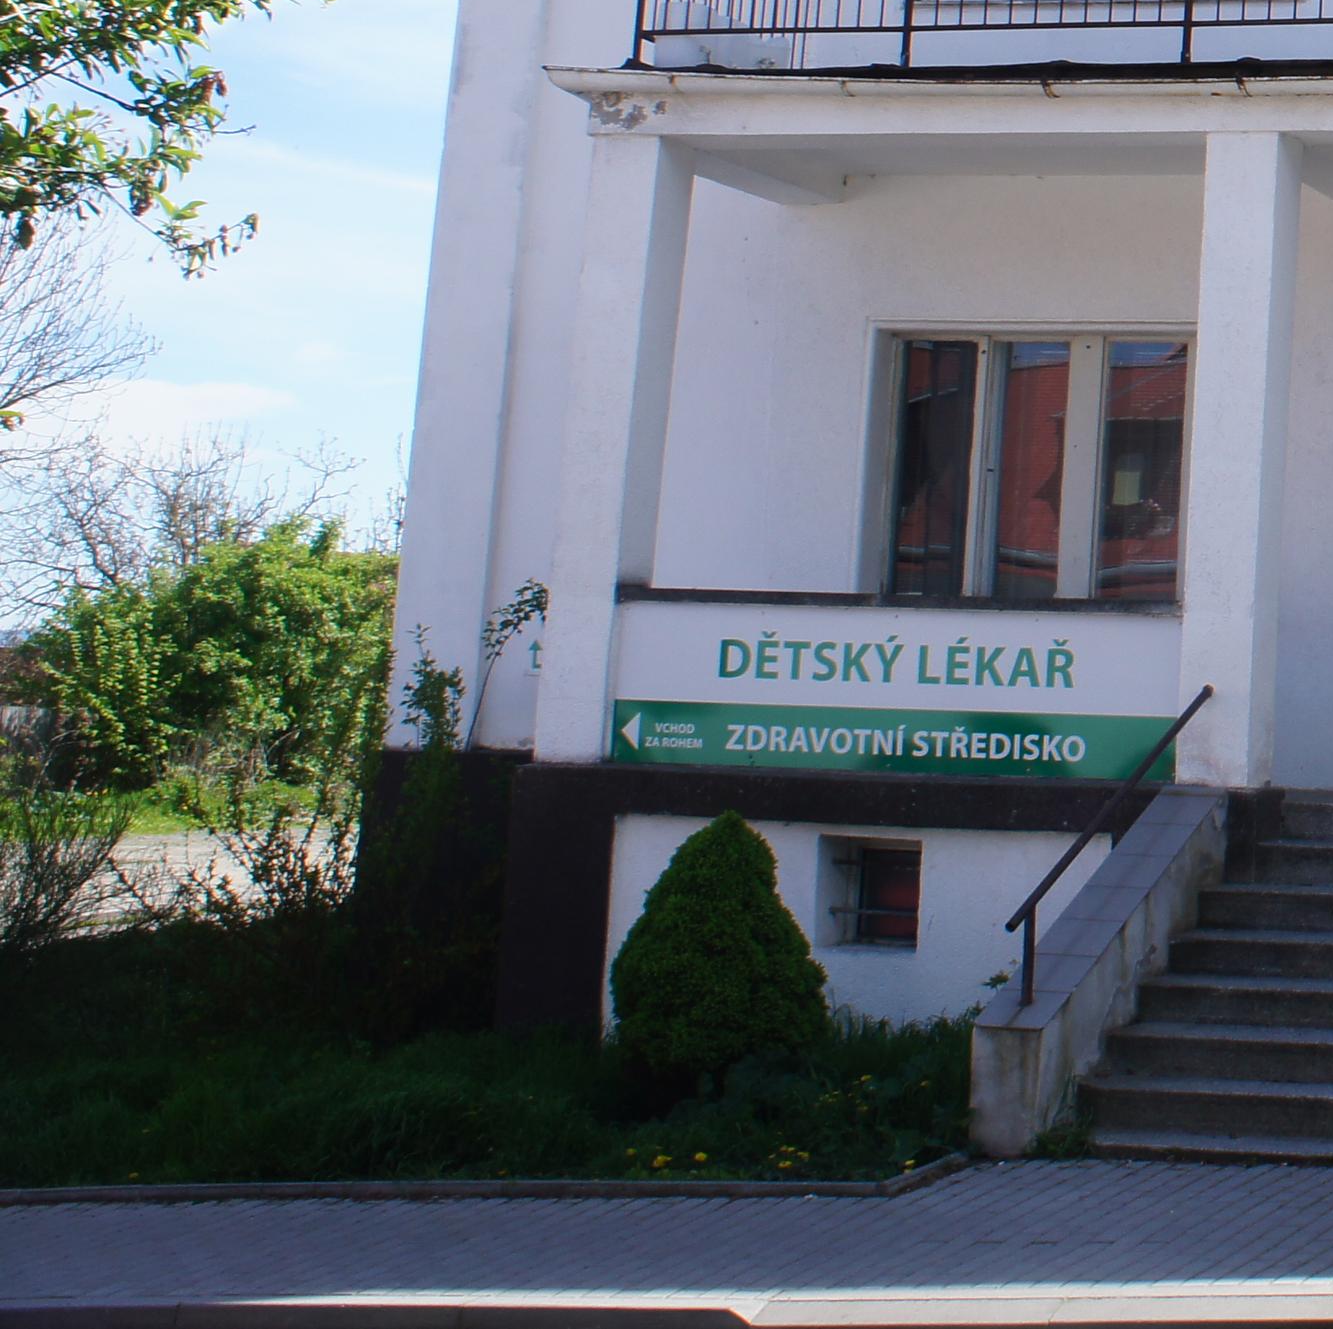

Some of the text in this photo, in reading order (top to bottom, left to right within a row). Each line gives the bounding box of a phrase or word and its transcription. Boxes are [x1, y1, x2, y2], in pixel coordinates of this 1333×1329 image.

[717, 631, 1075, 689] DĚTSKÝ LÉKAŘ
[655, 722, 696, 734] VCHOD
[644, 736, 703, 749] ZA ROHEM
[725, 723, 1087, 763] ZDRAVOTNÍ STŘEDISKO
